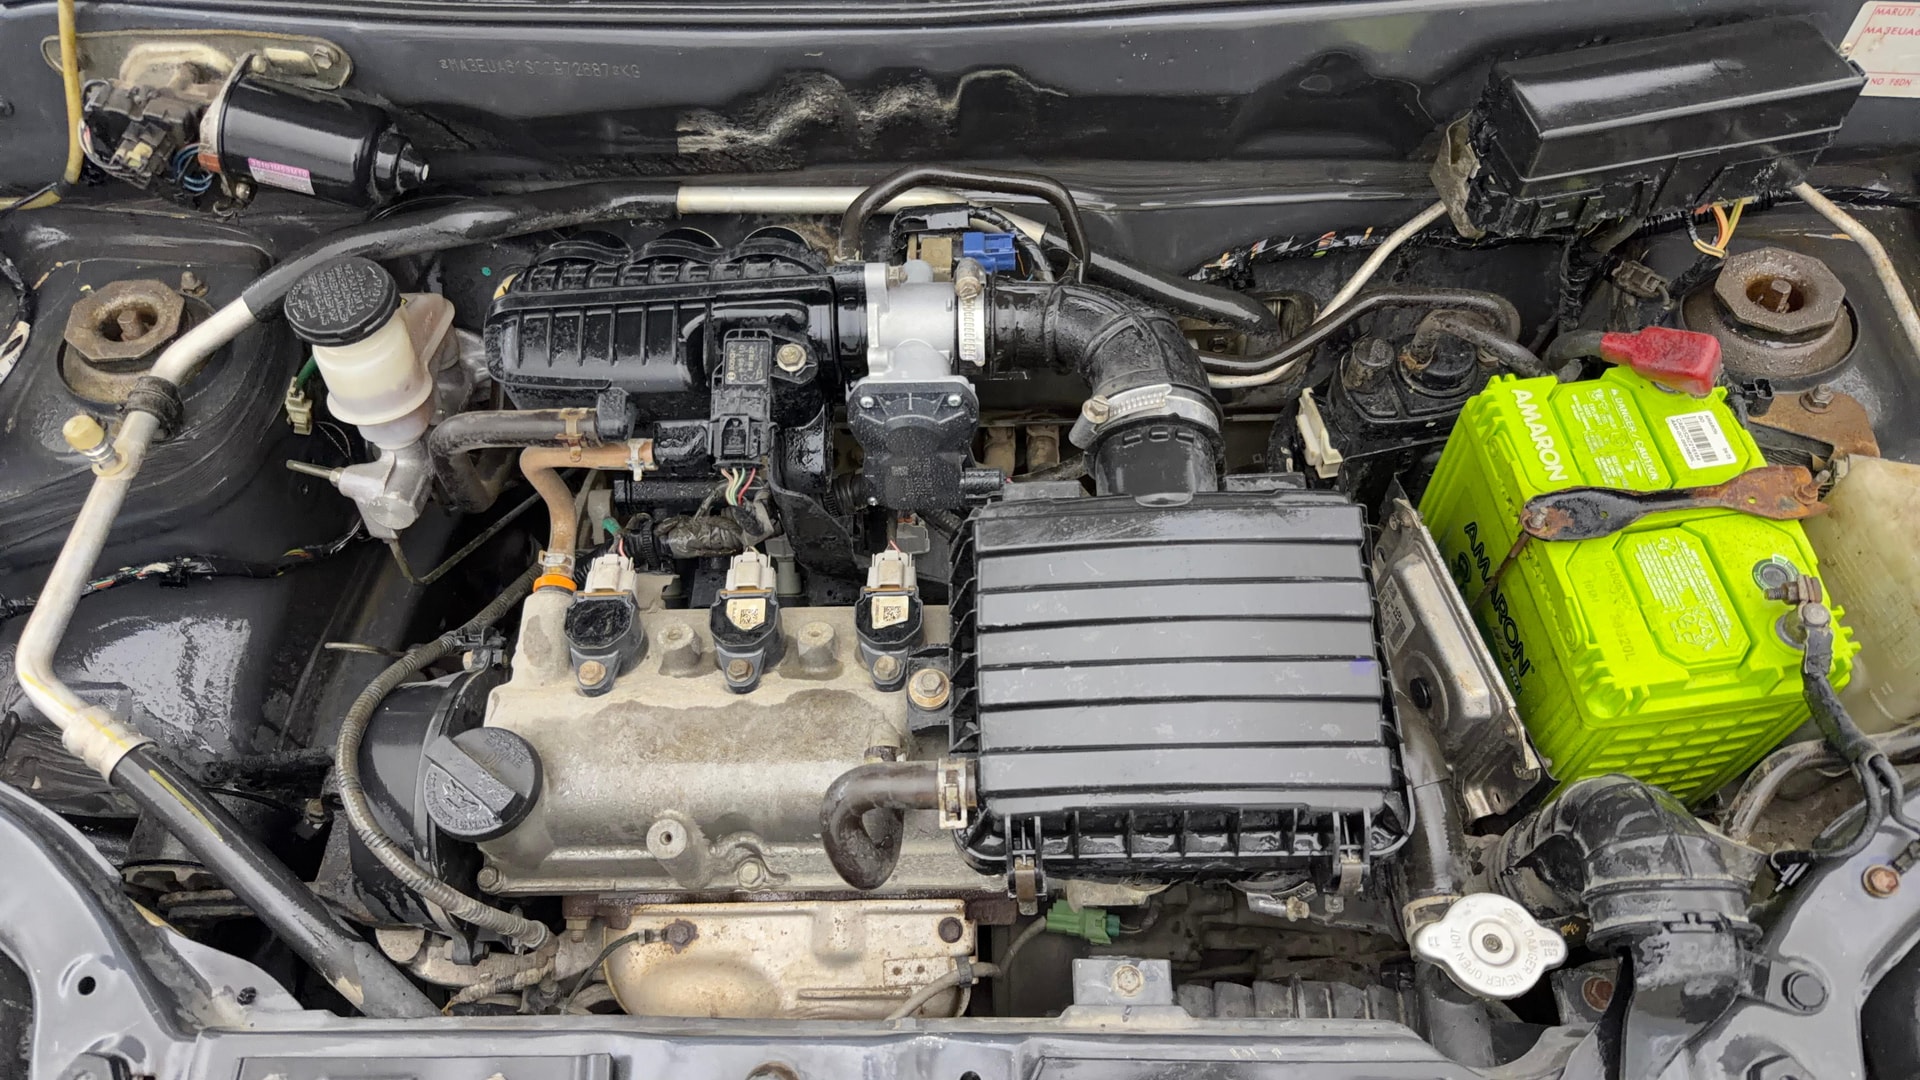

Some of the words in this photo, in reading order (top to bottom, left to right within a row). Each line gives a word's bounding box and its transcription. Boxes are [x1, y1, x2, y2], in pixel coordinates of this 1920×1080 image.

[1874, 7, 1916, 16] MARUTI
[1870, 78, 1885, 86] NO
[1511, 389, 1568, 482] AMARON
[1615, 397, 1637, 433] DANGER
[1634, 439, 1659, 481] CAUTION
[1450, 927, 1462, 950] HOT
[1523, 929, 1538, 975] DANGER
[1455, 951, 1484, 980] OPEN
[1485, 972, 1524, 988] NEVER
